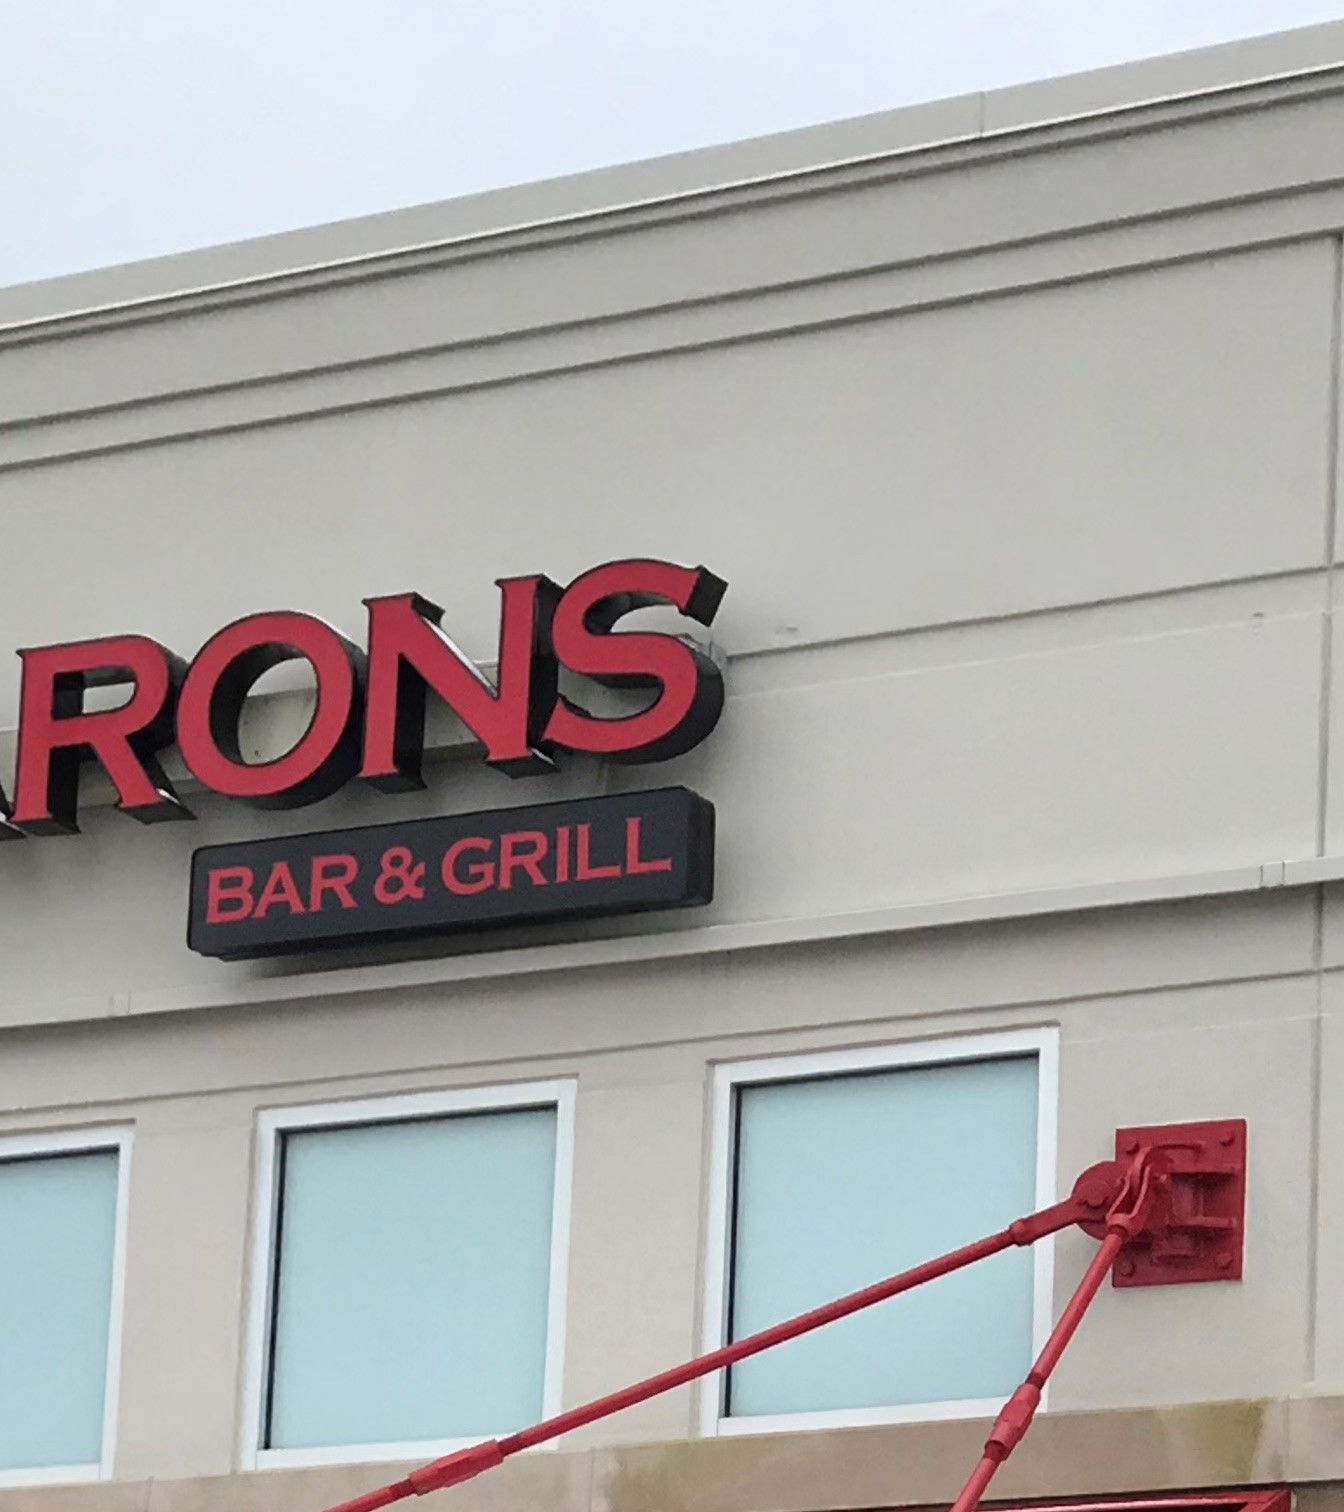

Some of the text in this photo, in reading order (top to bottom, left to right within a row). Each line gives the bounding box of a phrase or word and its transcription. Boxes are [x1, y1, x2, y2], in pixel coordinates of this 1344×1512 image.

[206, 816, 673, 924] BAR & GRILL
